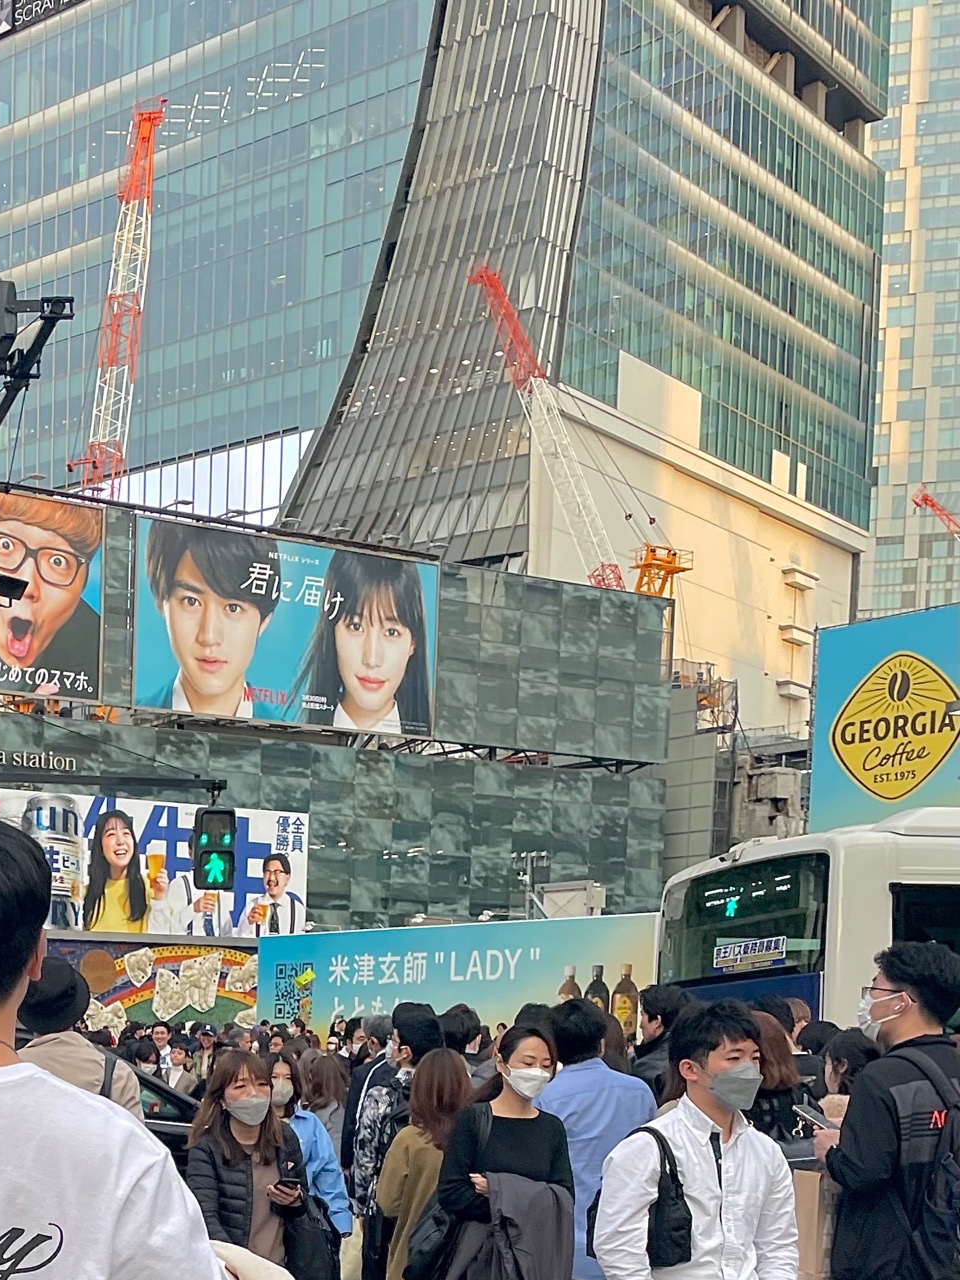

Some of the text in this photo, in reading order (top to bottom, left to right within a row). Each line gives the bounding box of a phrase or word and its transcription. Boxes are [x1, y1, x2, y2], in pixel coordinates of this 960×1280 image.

[268, 551, 300, 563] NETFLIX
[240, 562, 345, 621] 君に届け
[242, 687, 287, 705] NETFLIX
[840, 710, 956, 746] GEORGIA
[12, 749, 77, 771] station
[862, 740, 931, 772] Coffee
[290, 816, 306, 853] 全員
[328, 952, 428, 987] 米津玄師
